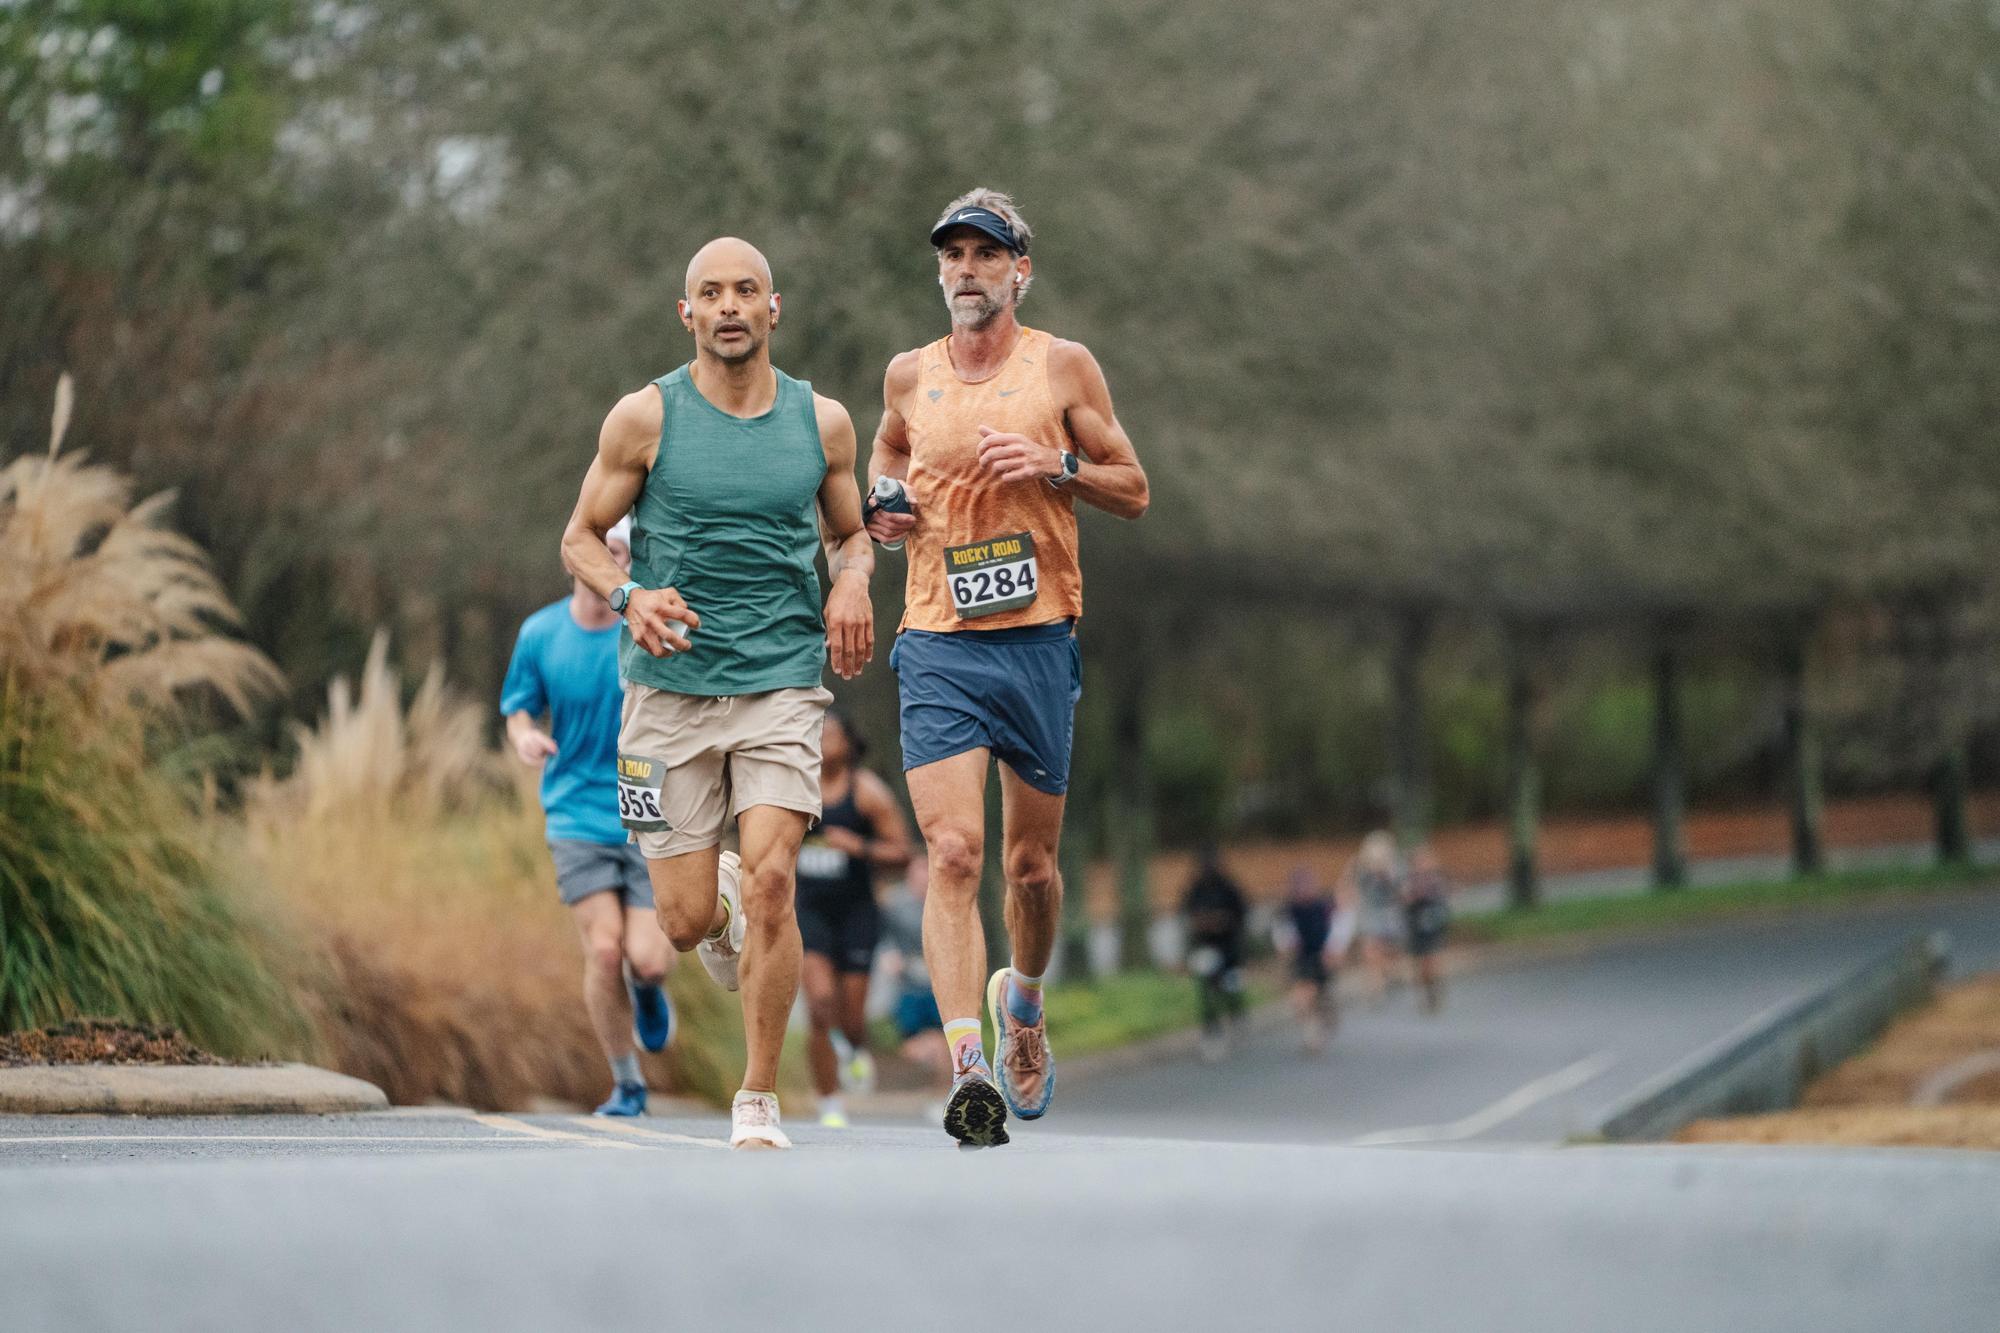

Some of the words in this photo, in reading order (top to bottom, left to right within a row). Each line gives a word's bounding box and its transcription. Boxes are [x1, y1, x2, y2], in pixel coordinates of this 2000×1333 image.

[952, 545, 989, 565] ROCKY
[991, 539, 1022, 558] ROAD
[953, 563, 1035, 605] 6284
[625, 760, 652, 778] ROAD
